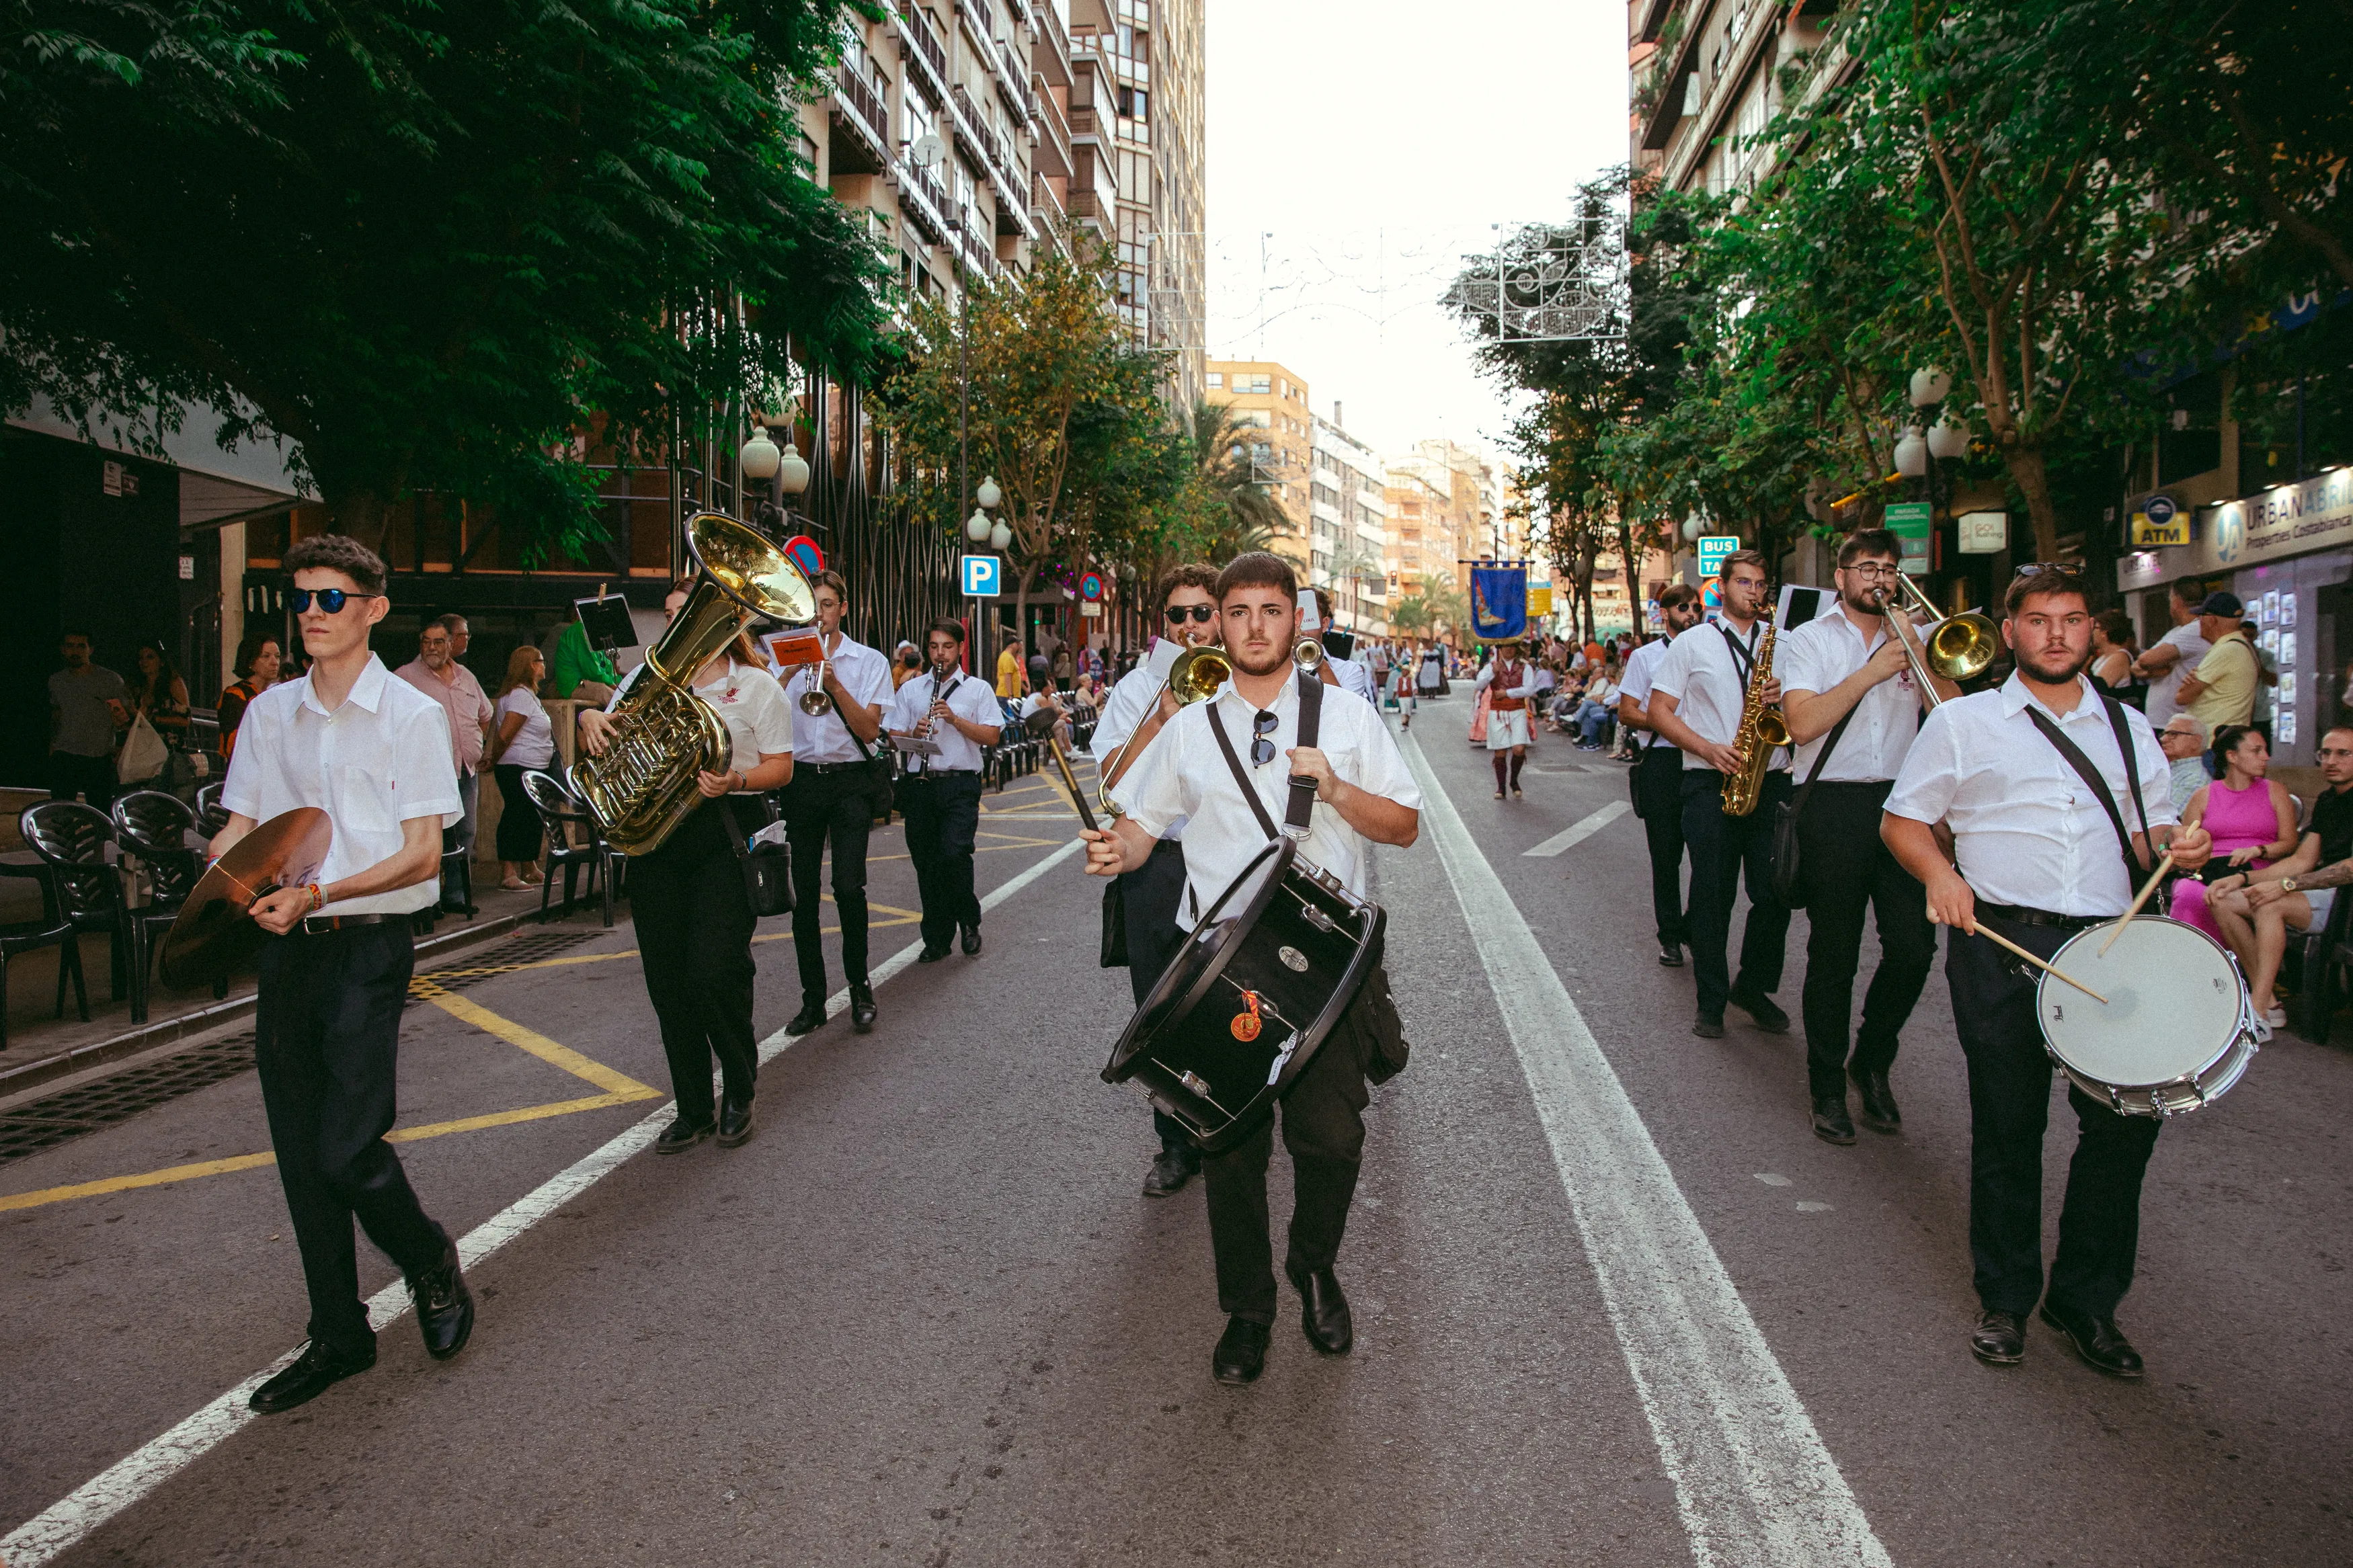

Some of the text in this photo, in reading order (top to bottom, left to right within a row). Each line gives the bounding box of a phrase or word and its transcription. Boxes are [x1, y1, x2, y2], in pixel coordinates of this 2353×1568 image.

[2141, 528, 2180, 542] ATM
[1704, 541, 1733, 552] BUS
[1704, 562, 1721, 572] TA
[970, 561, 992, 591] P
[2053, 1005, 2063, 1022] Pearl
